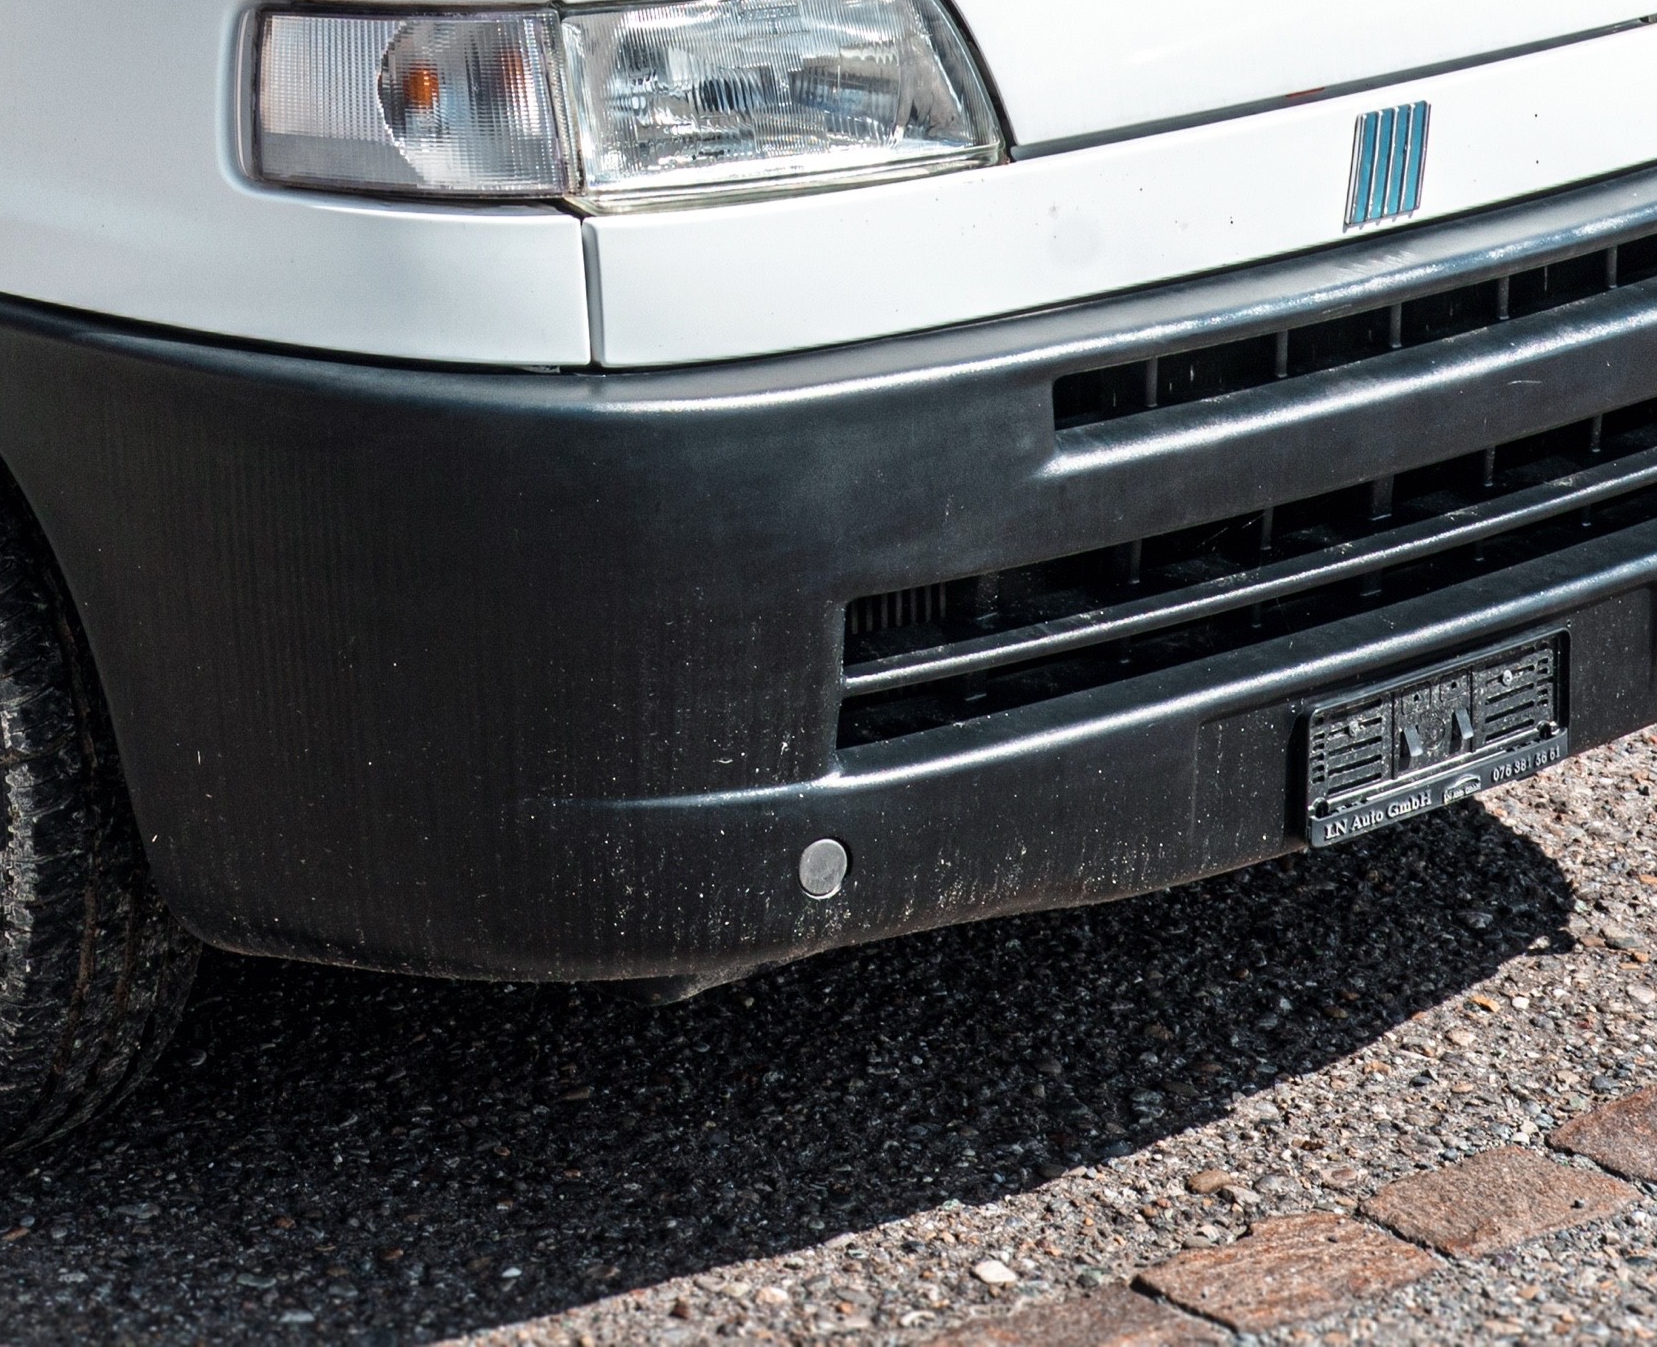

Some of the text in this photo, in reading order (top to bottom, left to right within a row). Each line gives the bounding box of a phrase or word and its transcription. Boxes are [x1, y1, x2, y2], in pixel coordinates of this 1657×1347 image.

[1492, 763, 1513, 782] 076
[1325, 789, 1433, 840] LN Auto GmbH
